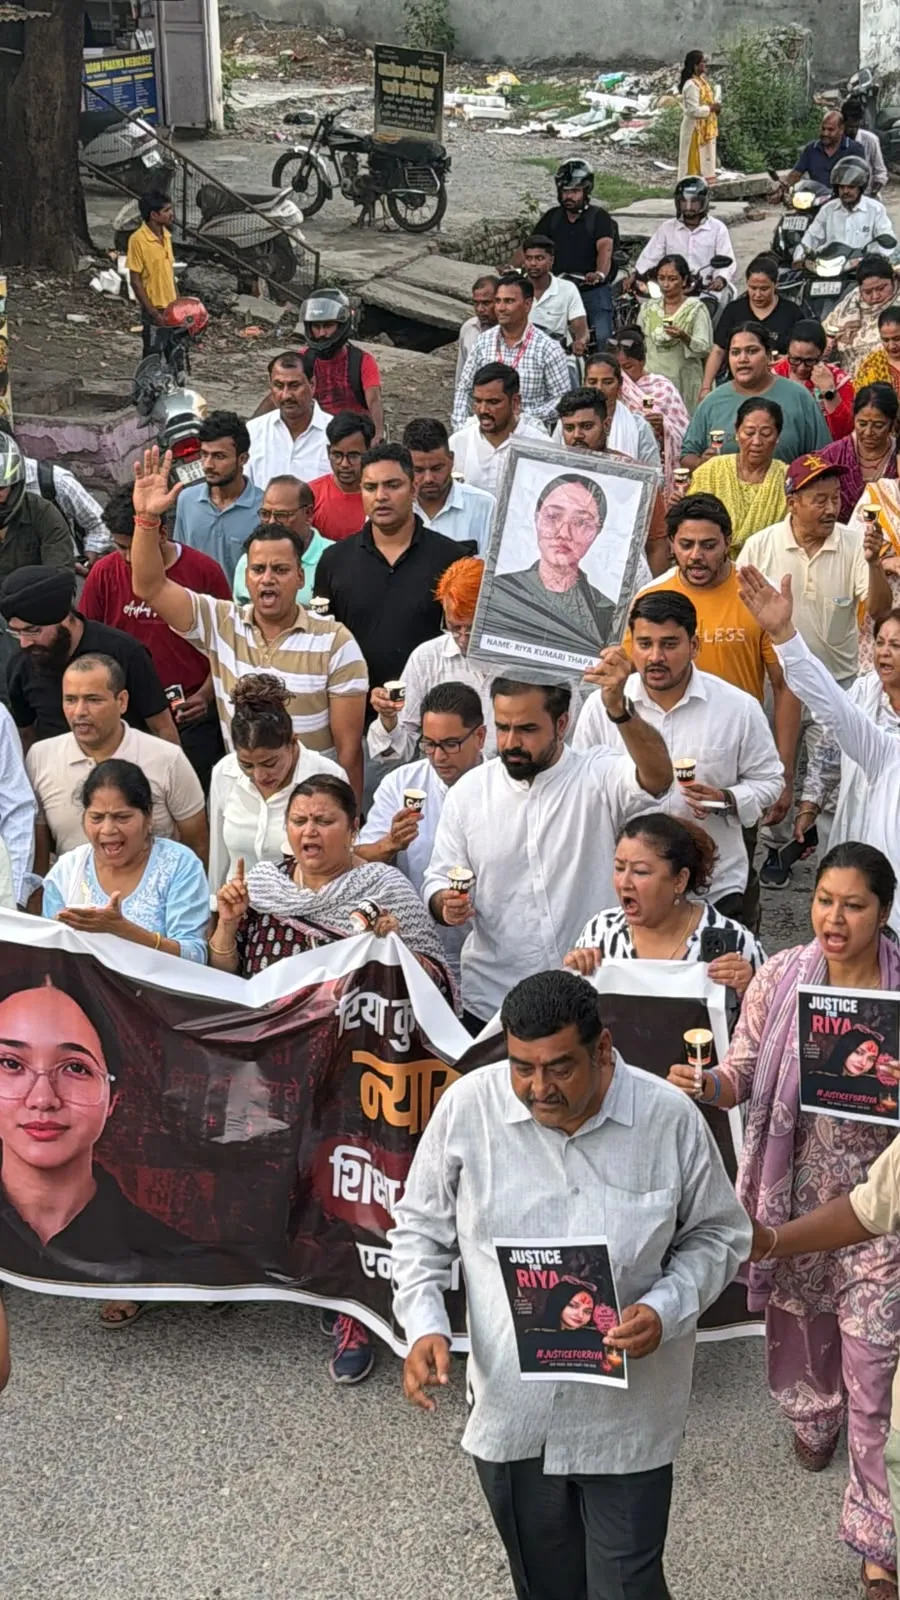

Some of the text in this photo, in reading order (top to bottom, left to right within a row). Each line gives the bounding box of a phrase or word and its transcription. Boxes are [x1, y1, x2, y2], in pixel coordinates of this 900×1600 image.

[514, 643, 533, 654] RIYA
[534, 648, 566, 661] KUMARI
[567, 654, 595, 667] THAPA
[808, 996, 859, 1014] JUSTICE
[334, 986, 416, 1052] रिया कु
[826, 1010, 838, 1018] FOR
[812, 1014, 853, 1036] RIYA
[816, 1088, 878, 1104] #JUSTICEFORRIYA
[508, 1249, 563, 1265] JUSTICE
[529, 1264, 542, 1272] FOR
[515, 1269, 560, 1290] RIYA
[536, 1348, 604, 1361] #JUSTICEFORRIYA
